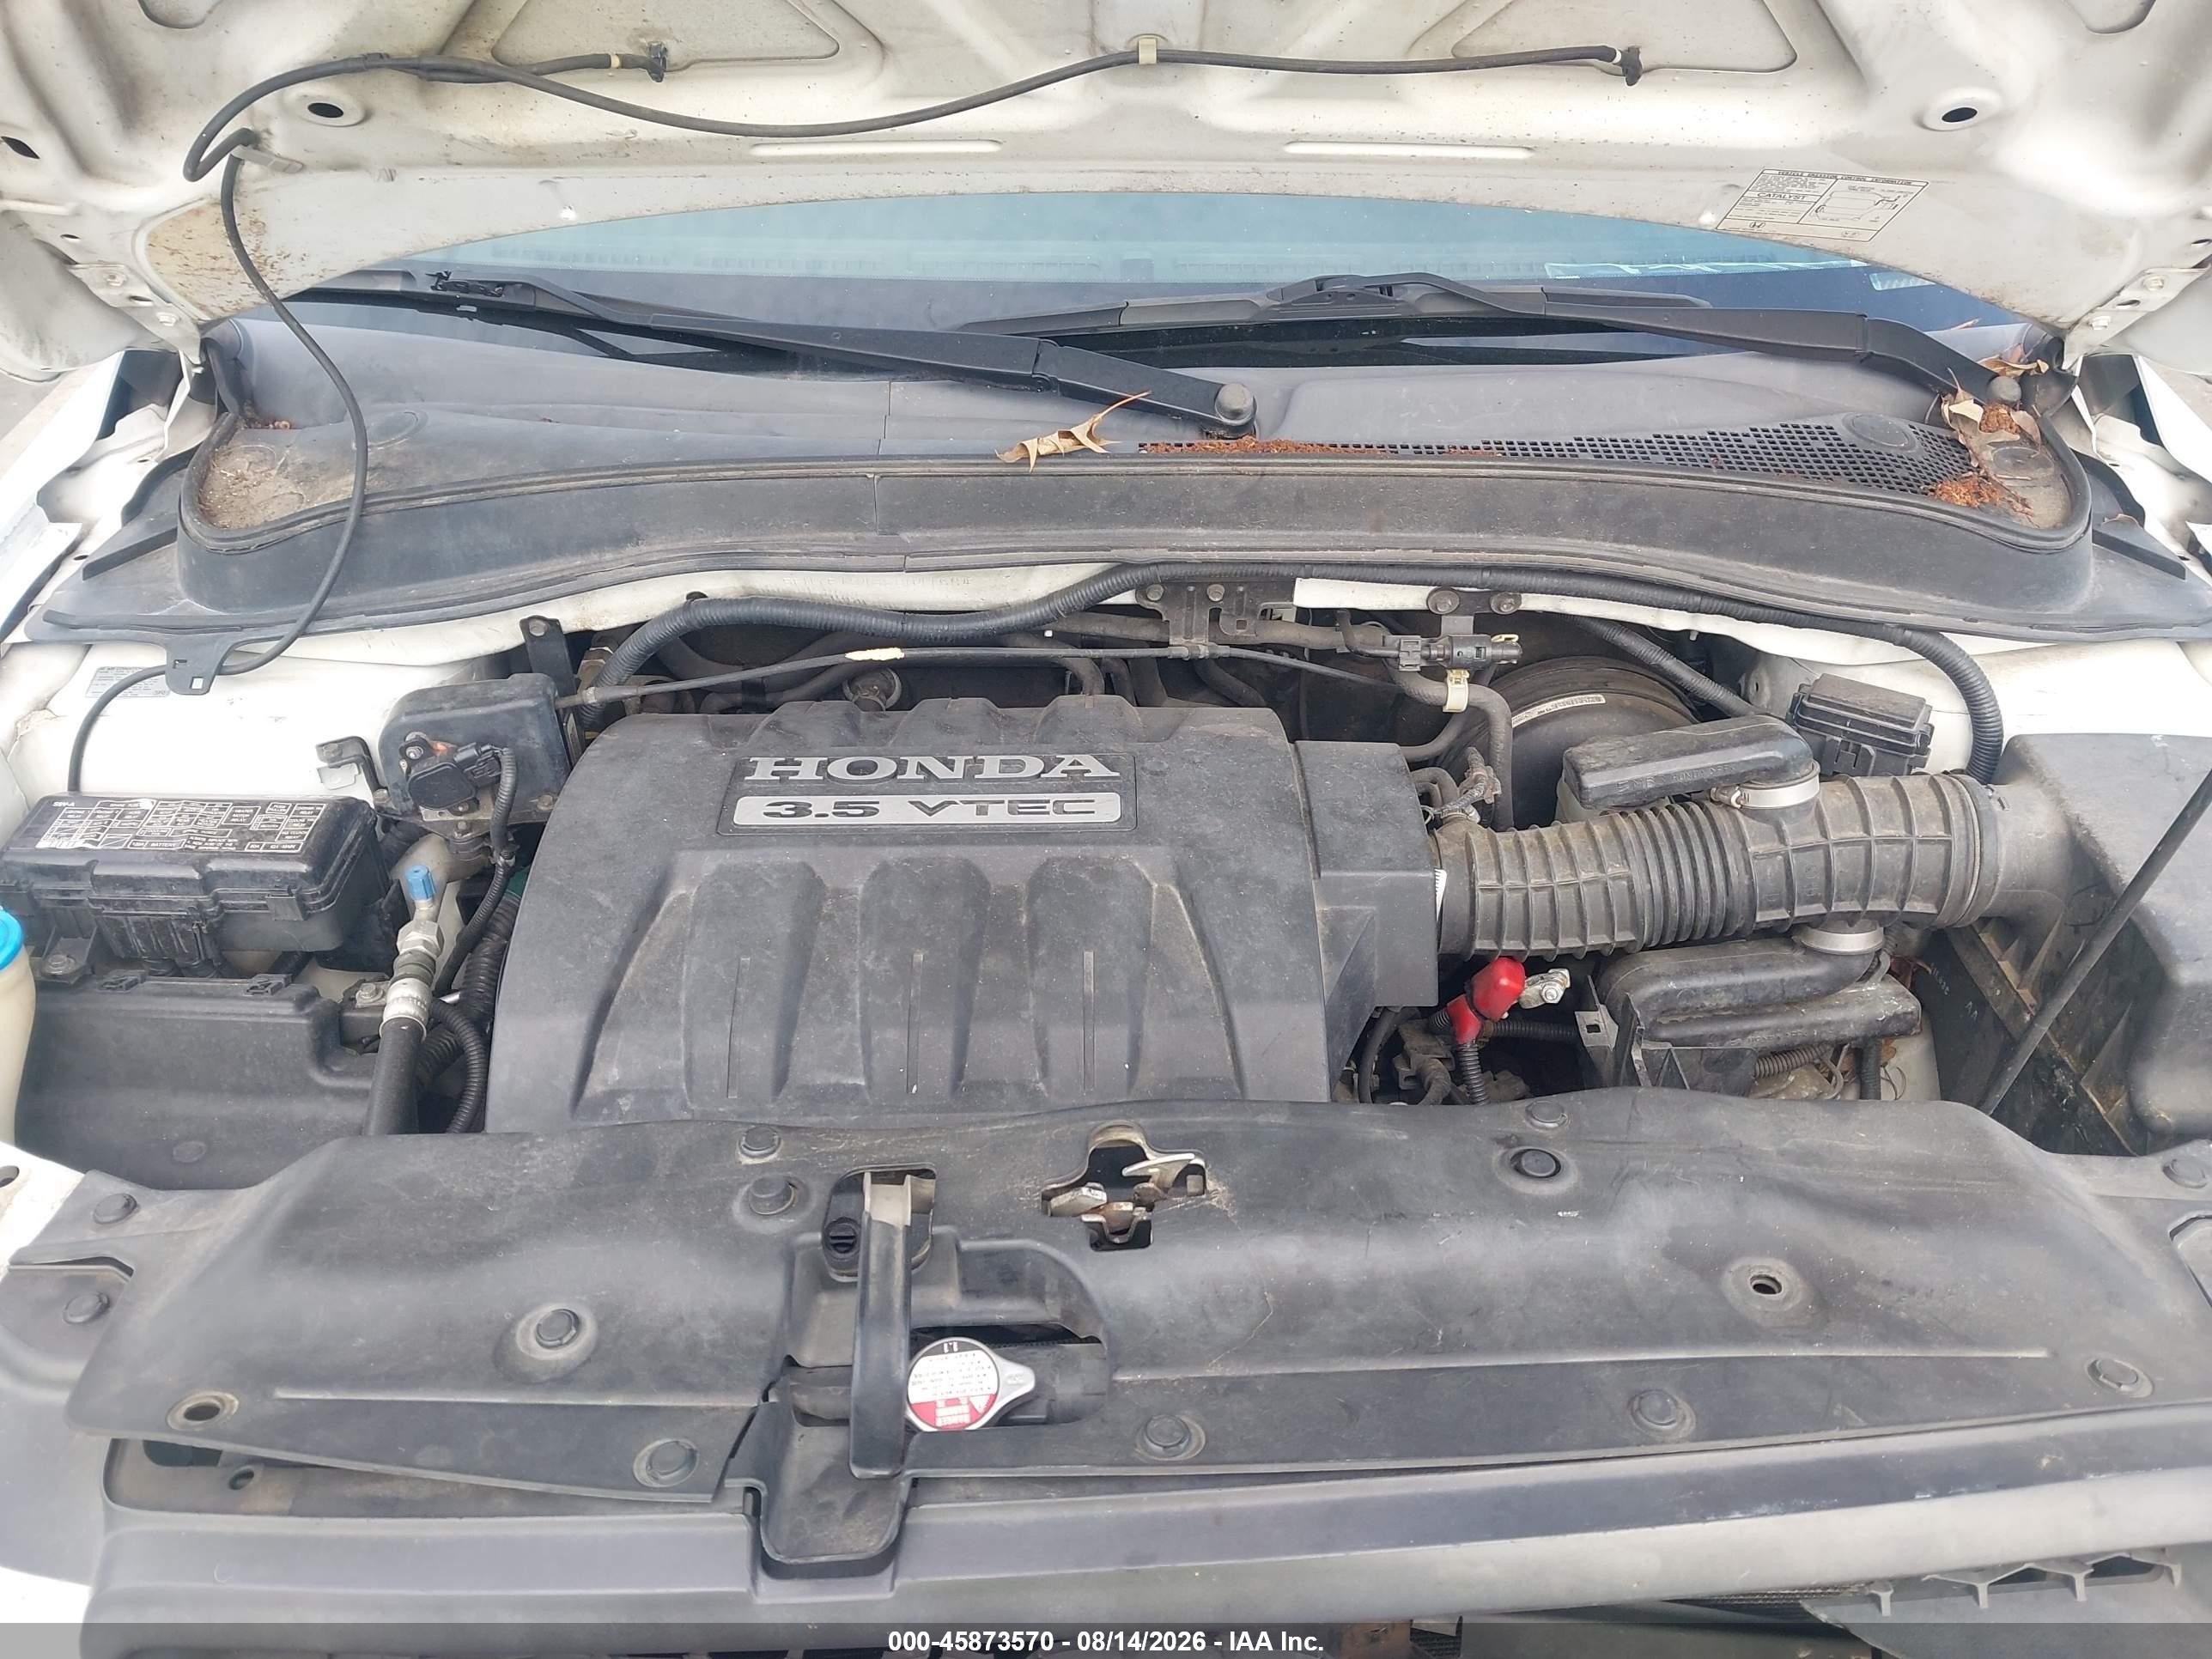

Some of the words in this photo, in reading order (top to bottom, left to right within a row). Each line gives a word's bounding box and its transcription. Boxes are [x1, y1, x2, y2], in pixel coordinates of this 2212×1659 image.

[1757, 191, 1808, 201] CATALYST
[744, 755, 1120, 783] HONDA
[763, 800, 880, 819] 3.5
[907, 799, 1097, 817] VTEC
